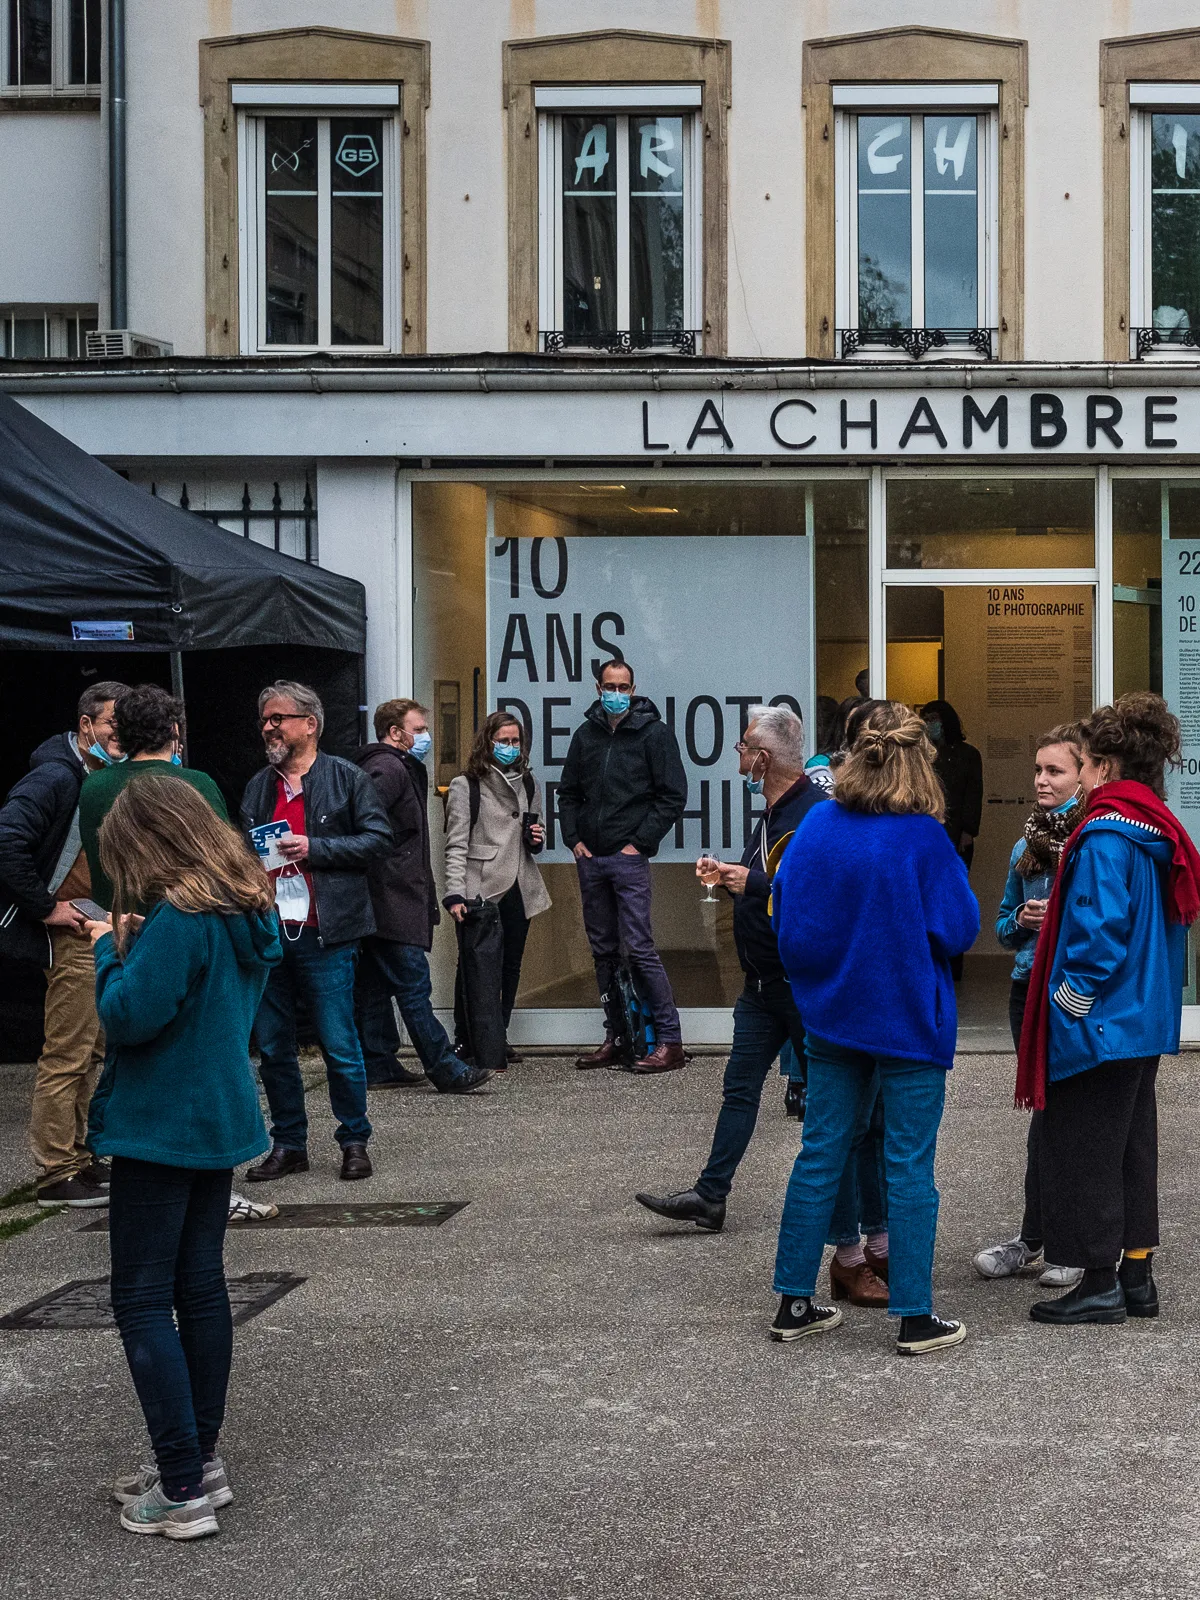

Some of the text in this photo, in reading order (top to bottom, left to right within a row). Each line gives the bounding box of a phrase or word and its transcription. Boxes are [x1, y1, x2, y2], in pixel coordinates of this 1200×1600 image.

[341, 149, 373, 162] G5
[643, 394, 1178, 449] LA CHAMBRE
[495, 537, 567, 599] 10
[987, 588, 1024, 601] 10 ANS
[988, 603, 1084, 616] DE PHOTOGRAPHIE
[1179, 595, 1196, 612] 10
[1179, 615, 1196, 632] DE
[498, 611, 625, 682] ANS
